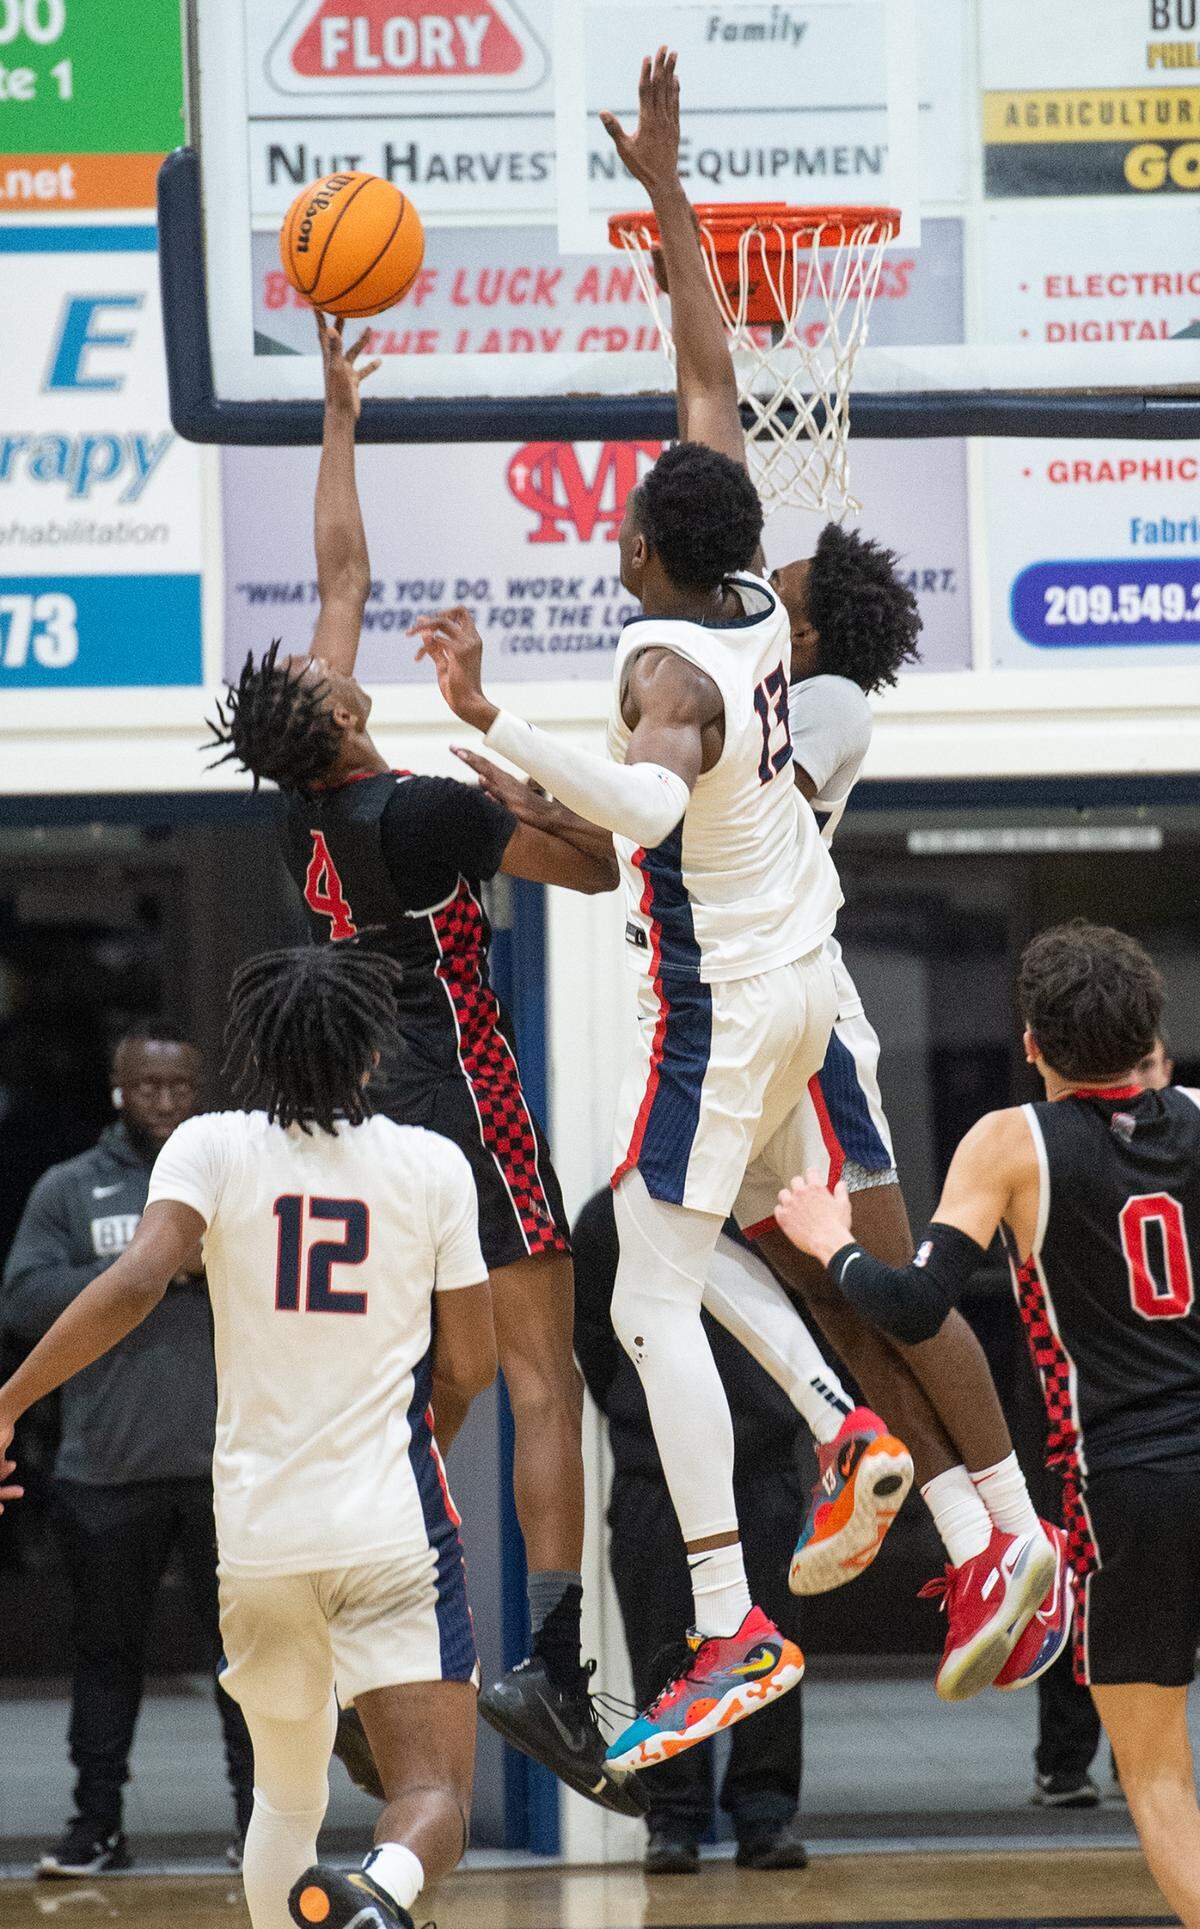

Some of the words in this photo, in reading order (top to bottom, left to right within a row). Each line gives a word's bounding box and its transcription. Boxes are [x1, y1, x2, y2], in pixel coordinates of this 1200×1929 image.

[321, 15, 491, 70] FLORY
[51, 58, 73, 101] 1
[1004, 99, 1200, 127] AGRICULTUR
[1123, 143, 1200, 191] GO
[296, 174, 356, 253] Wilson
[450, 267, 563, 307] LUCK
[40, 291, 147, 393] E
[0, 430, 176, 505] rapy
[1047, 457, 1200, 484] GRAPHIC
[1130, 515, 1200, 545] Fabri
[397, 577, 445, 602] YOU
[507, 576, 583, 600] WORK
[487, 605, 535, 629] FOR
[548, 604, 593, 628] THE
[753, 658, 794, 787] 13
[305, 829, 358, 942] 4
[272, 1193, 370, 1315] 12
[1119, 1191, 1195, 1321] 0
